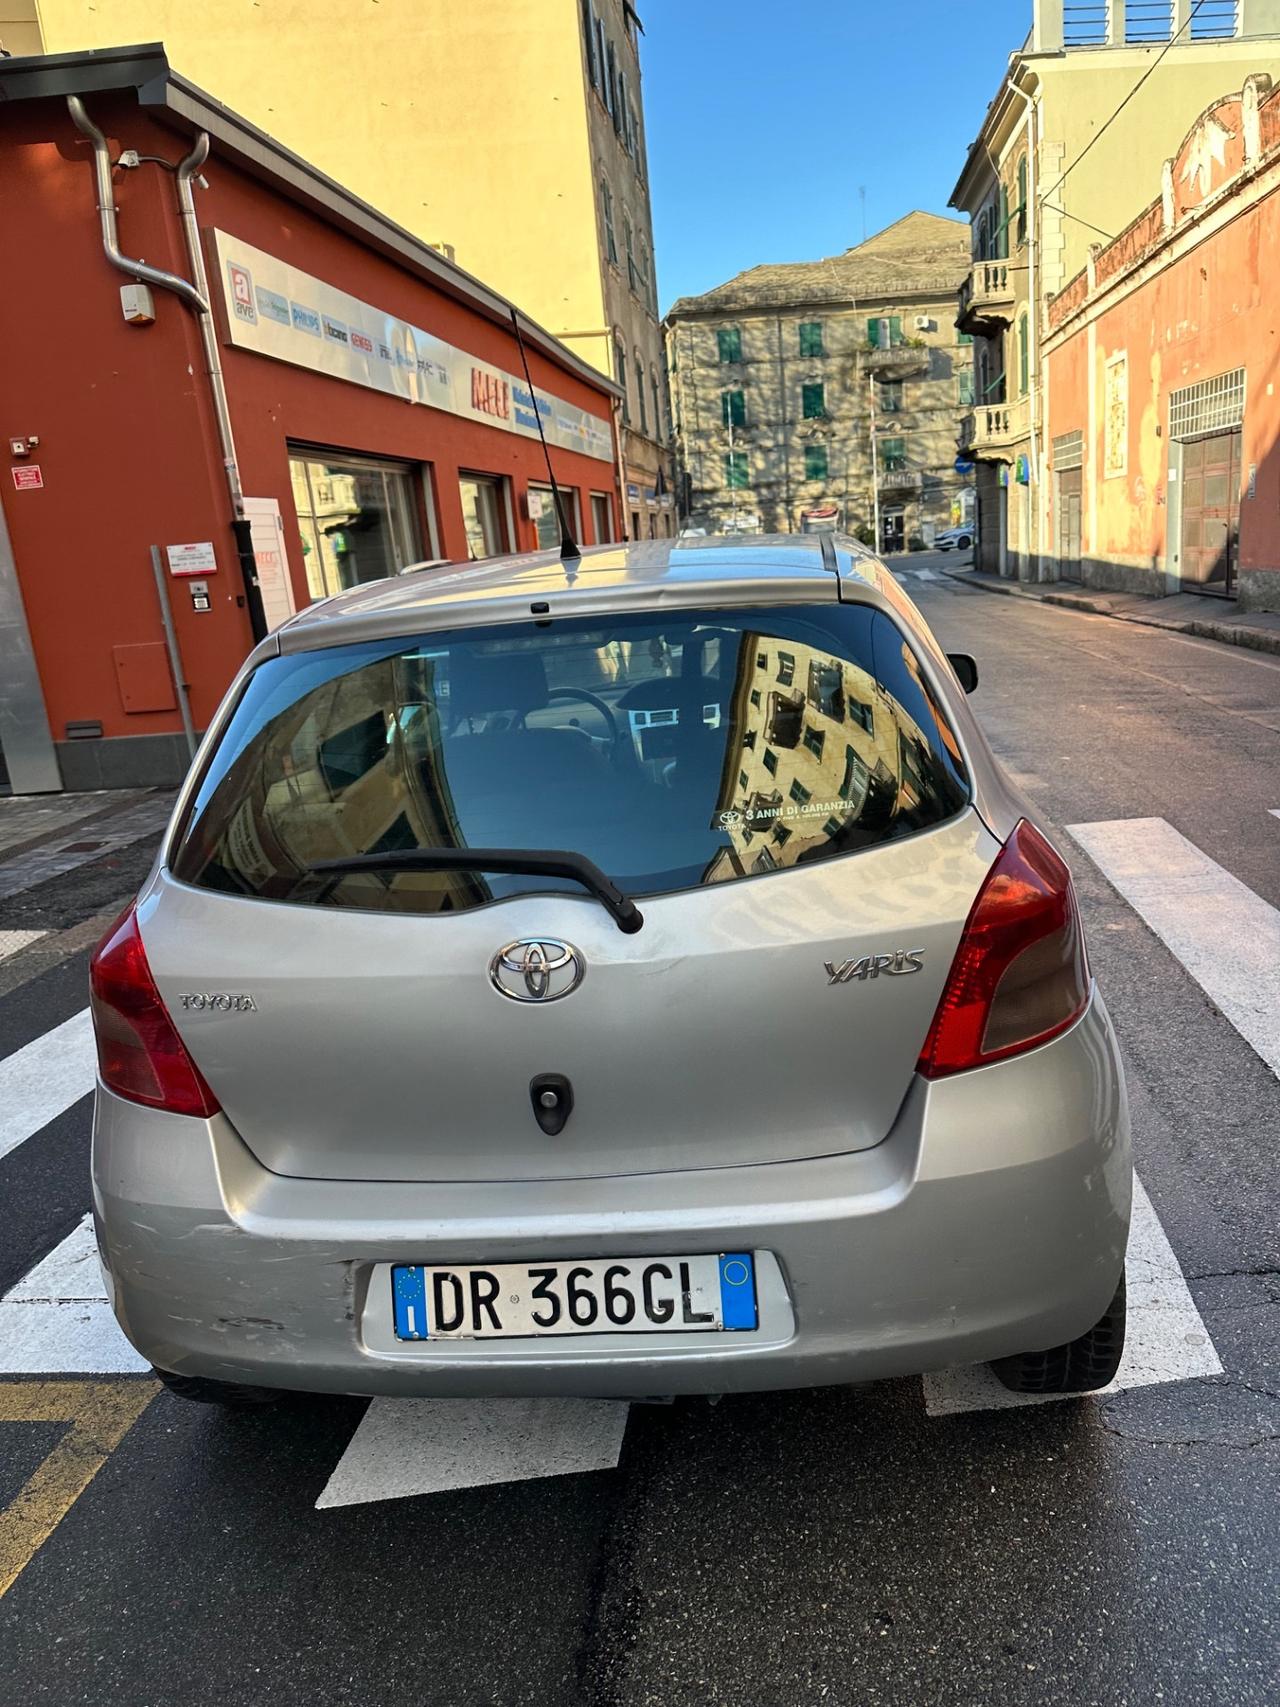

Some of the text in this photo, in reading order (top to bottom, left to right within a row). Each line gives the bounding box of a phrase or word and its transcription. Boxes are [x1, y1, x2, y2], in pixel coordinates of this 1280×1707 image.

[236, 302, 255, 319] ave
[745, 800, 855, 821] 3 ANNI DI GARANZIA
[718, 823, 747, 832] TOYOTA
[178, 992, 257, 1012] TOYOTA
[432, 1262, 715, 1332] DR 366GL
